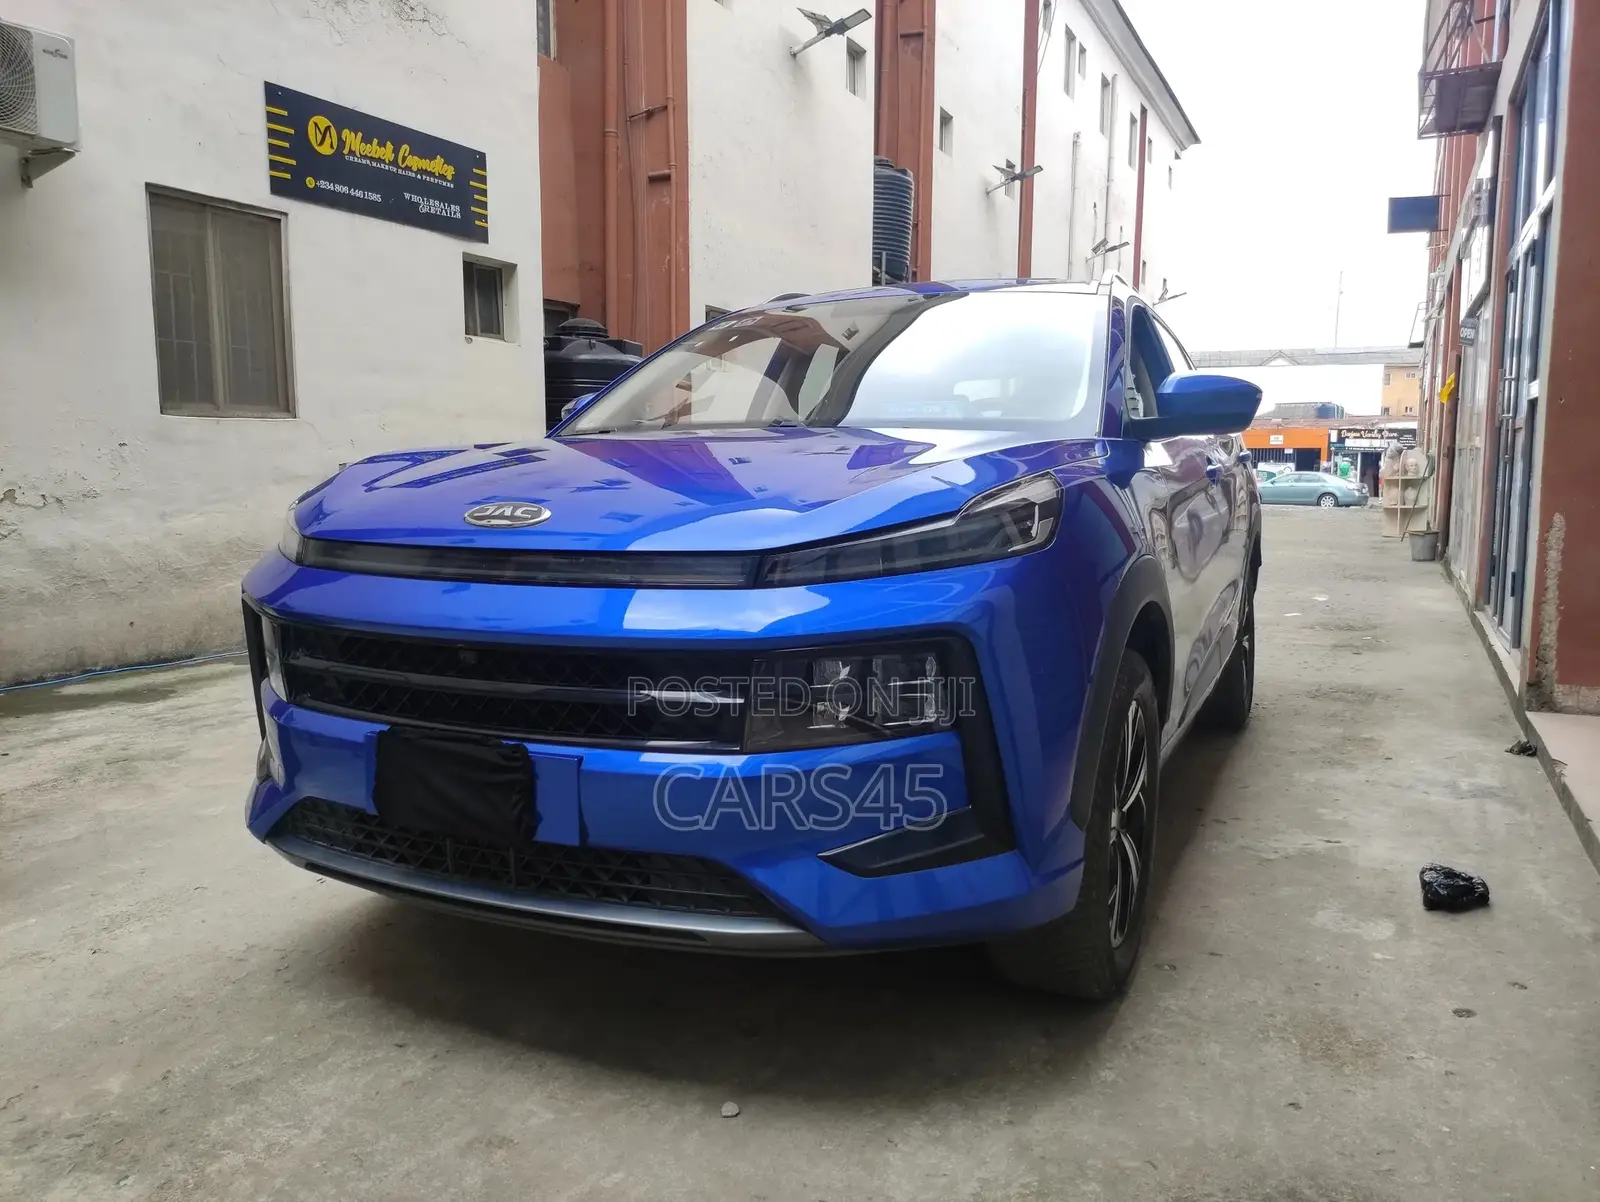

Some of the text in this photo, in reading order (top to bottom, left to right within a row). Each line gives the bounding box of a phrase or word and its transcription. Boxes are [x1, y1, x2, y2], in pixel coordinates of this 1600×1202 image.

[316, 180, 334, 191] +234
[403, 192, 461, 213] WHOLESALES
[1460, 327, 1475, 339] OPEN
[473, 505, 538, 518] JAC
